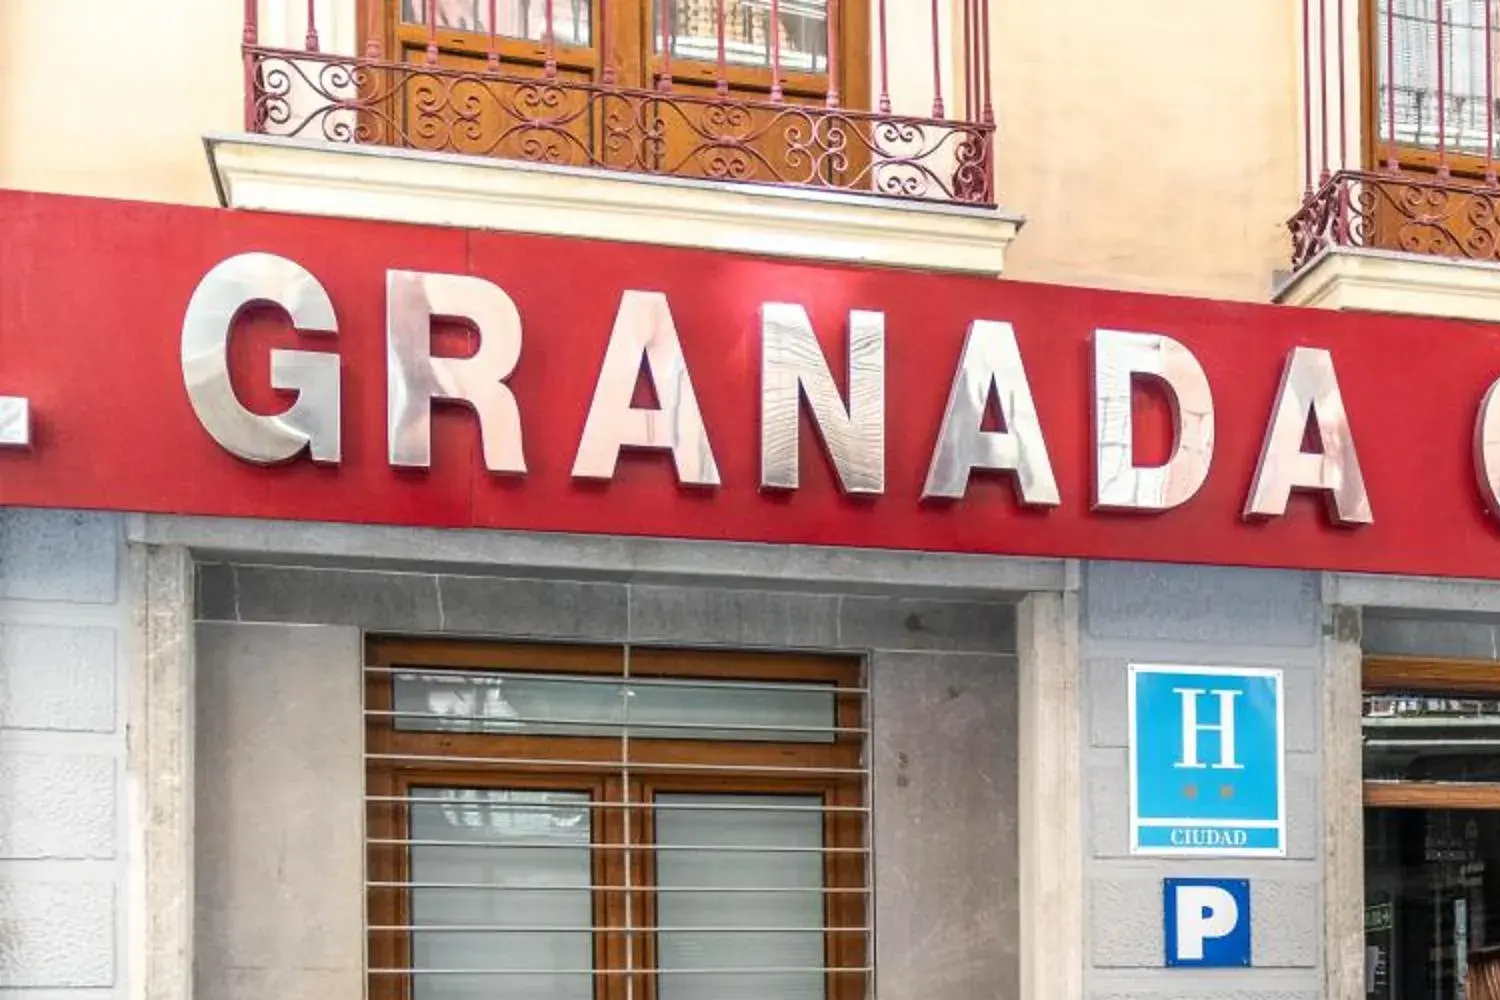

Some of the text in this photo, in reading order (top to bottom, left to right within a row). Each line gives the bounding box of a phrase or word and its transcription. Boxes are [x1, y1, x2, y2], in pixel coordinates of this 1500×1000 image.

[181, 252, 1374, 524] GRANADA
[1172, 687, 1244, 769] H
[1170, 828, 1248, 846] CIUDAD
[1176, 885, 1239, 960] P
